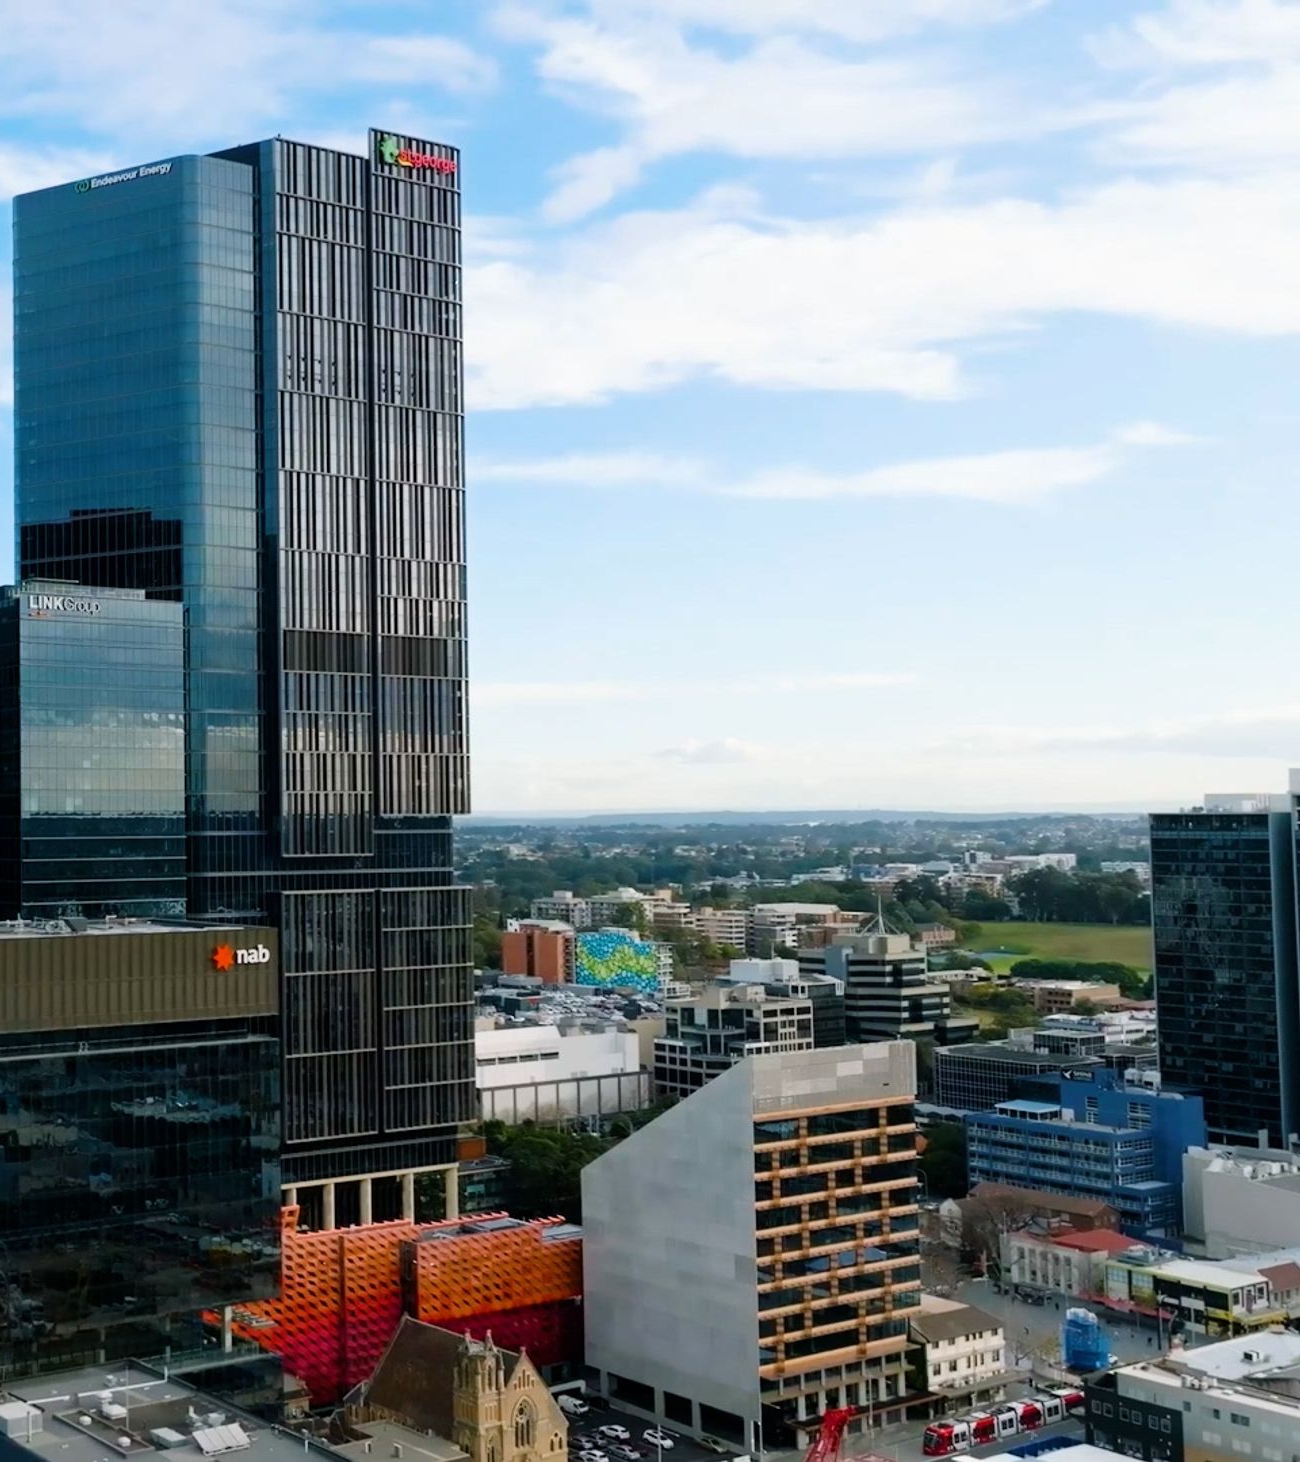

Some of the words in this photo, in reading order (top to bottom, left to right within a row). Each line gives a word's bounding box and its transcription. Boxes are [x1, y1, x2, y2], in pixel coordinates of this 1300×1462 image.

[91, 170, 138, 189] Endeavour
[139, 162, 172, 177] Energy
[236, 943, 270, 964] nab
